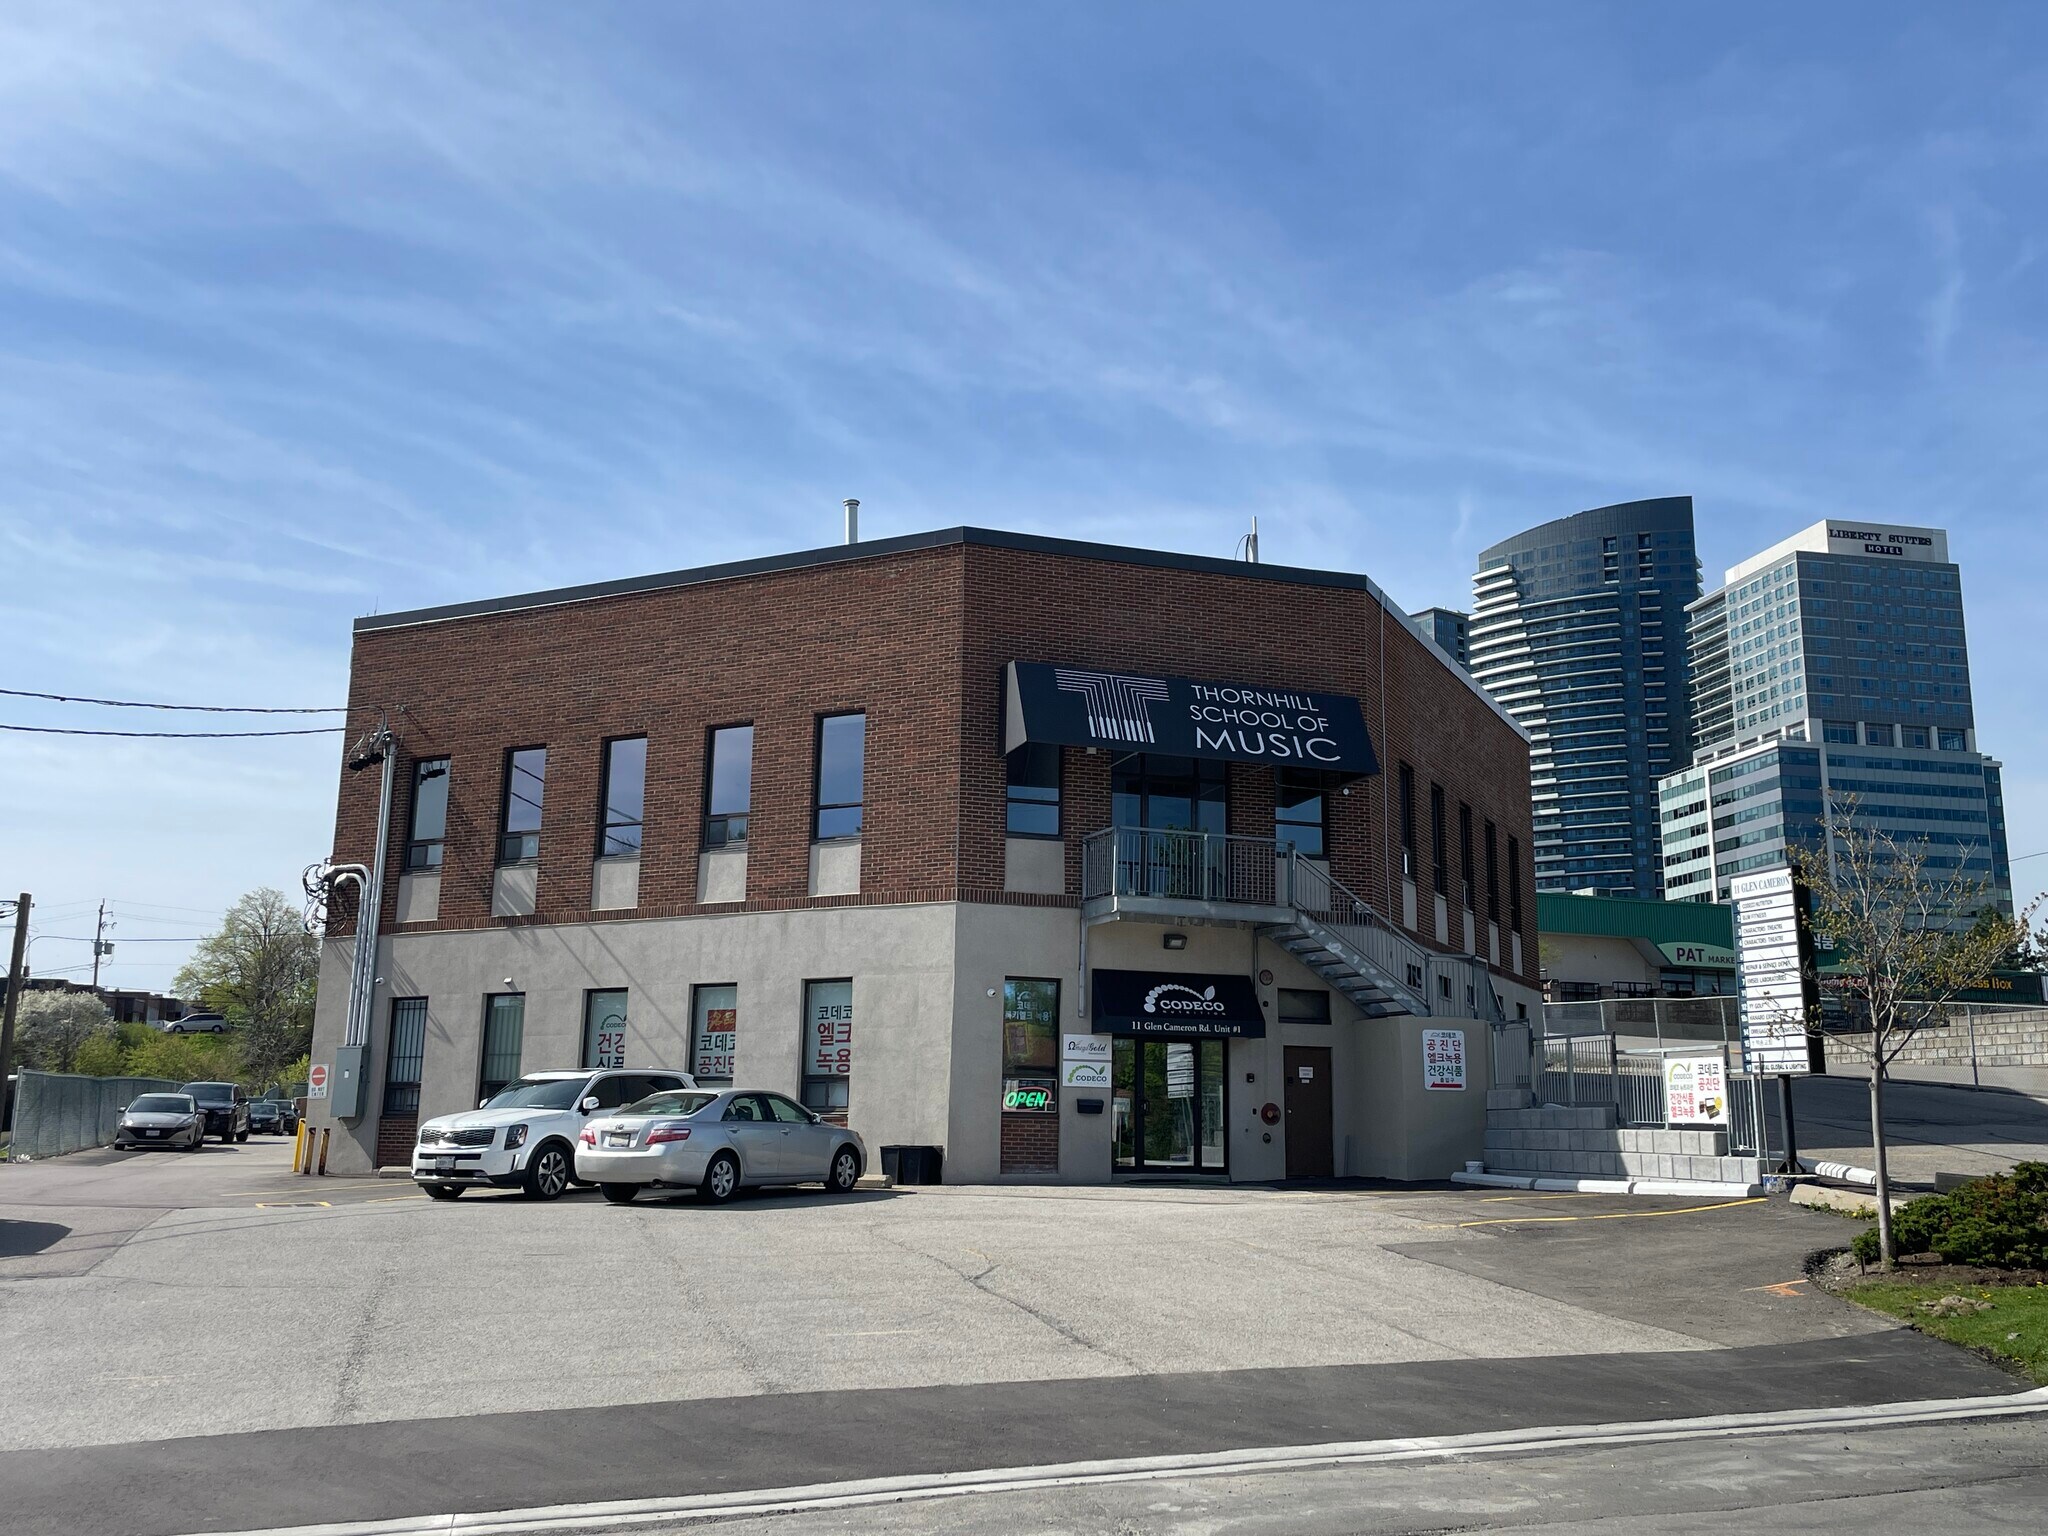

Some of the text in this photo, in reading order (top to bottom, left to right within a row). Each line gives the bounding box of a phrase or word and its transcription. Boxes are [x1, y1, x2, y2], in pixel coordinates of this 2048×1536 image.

[1829, 529, 1932, 546] LIBERTY SUITES
[1868, 545, 1901, 554] HOTEL
[1190, 685, 1320, 712] THORNHILL
[1189, 705, 1330, 732] SCHOOL OF
[1195, 726, 1341, 762] MUSIC
[1734, 875, 1790, 894] 11 GLEN CAMERON
[1676, 947, 1735, 965] PAT MARKE
[818, 1005, 852, 1020] 코데코
[1159, 999, 1225, 1012] CODECO
[817, 1022, 851, 1046] 엘크
[1131, 1021, 1141, 1030] 11
[1144, 1022, 1162, 1031] Glen
[1163, 1022, 1197, 1032] Cameron
[1198, 1024, 1211, 1033] Rd.
[1214, 1024, 1231, 1034] Unit
[816, 1048, 851, 1073] 녹용
[1427, 1052, 1462, 1065] 엘크녹용
[1428, 1065, 1463, 1077] 건강식품
[1697, 1063, 1720, 1076] 코데코
[1075, 1074, 1107, 1082] CODECO
[1697, 1077, 1720, 1091] 공진단
[1005, 1091, 1047, 1107] OPEN
